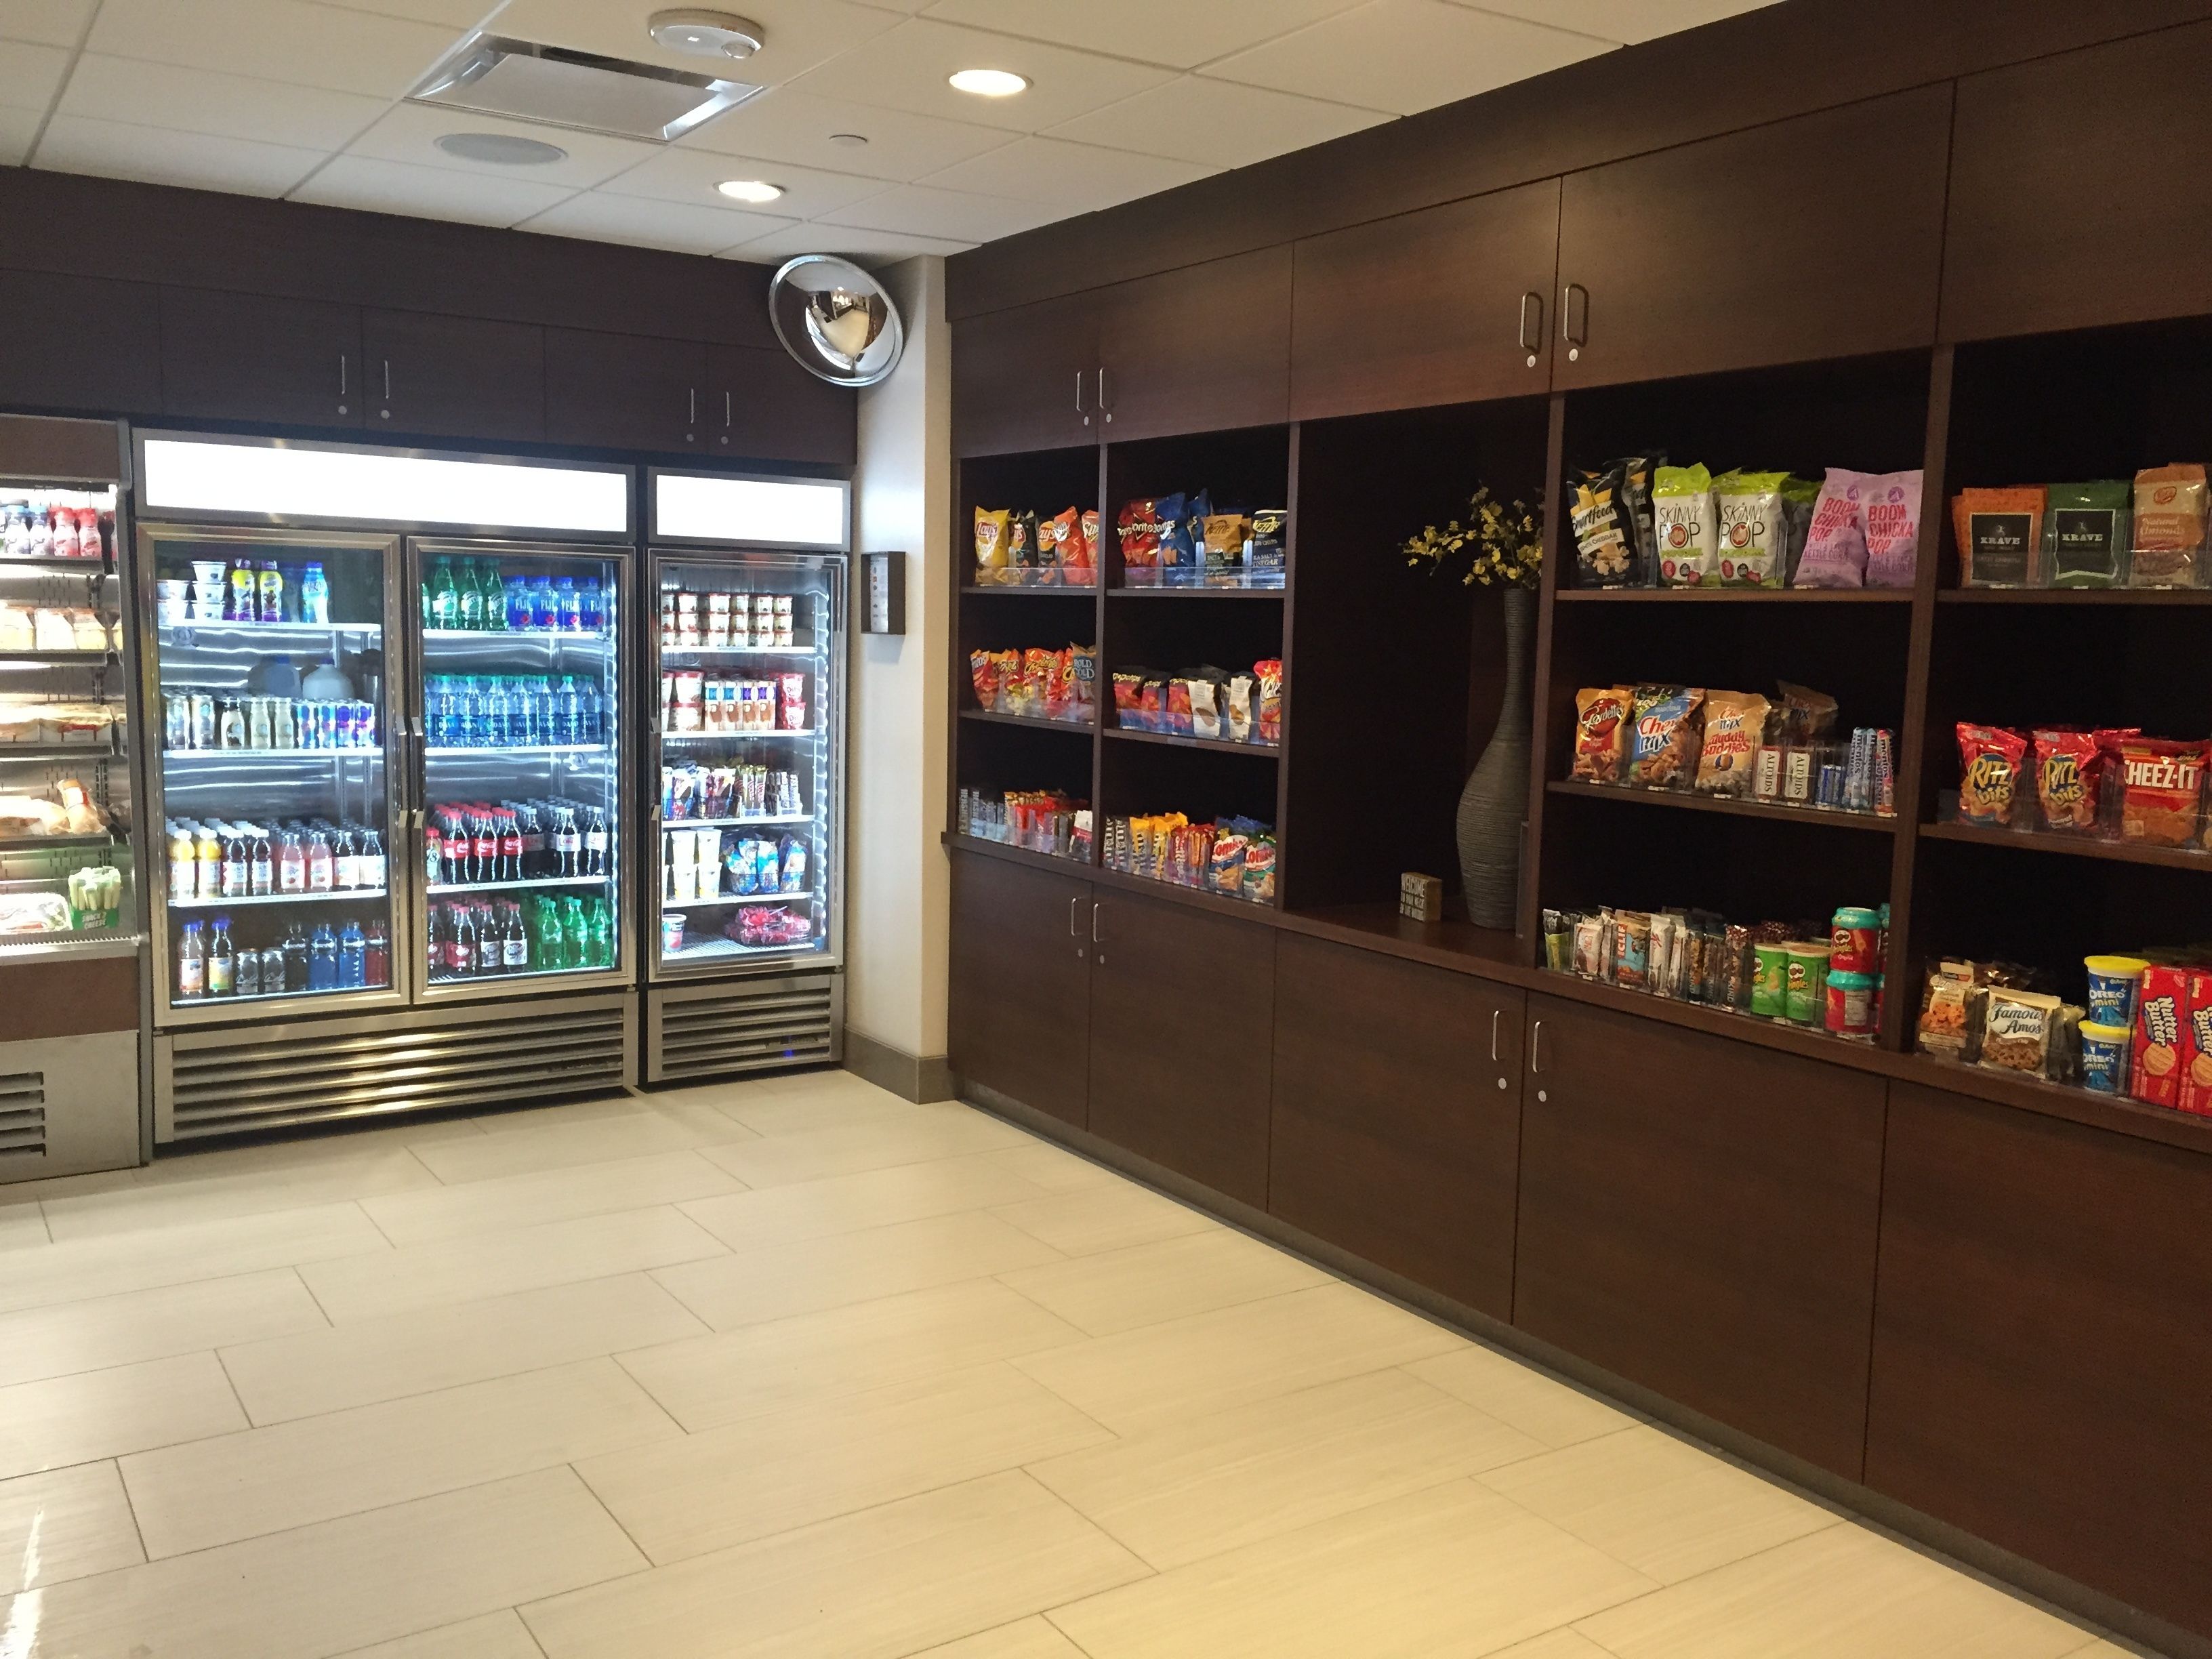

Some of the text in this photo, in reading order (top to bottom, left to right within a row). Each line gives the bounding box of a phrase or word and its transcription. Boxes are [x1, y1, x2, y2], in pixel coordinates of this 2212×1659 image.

[1868, 504, 1907, 522] BOOM
[1980, 537, 2020, 545] KRAVE
[2062, 533, 2103, 541] KRAVE
[1968, 758, 2013, 789] RITZ
[2089, 989, 2125, 1000] OREO
[2095, 998, 2119, 1006] mini
[1988, 1002, 2045, 1023] Famous
[2157, 996, 2178, 1044] Nutter
[2001, 1019, 2045, 1035] Amos
[2144, 1000, 2167, 1048] Butter
